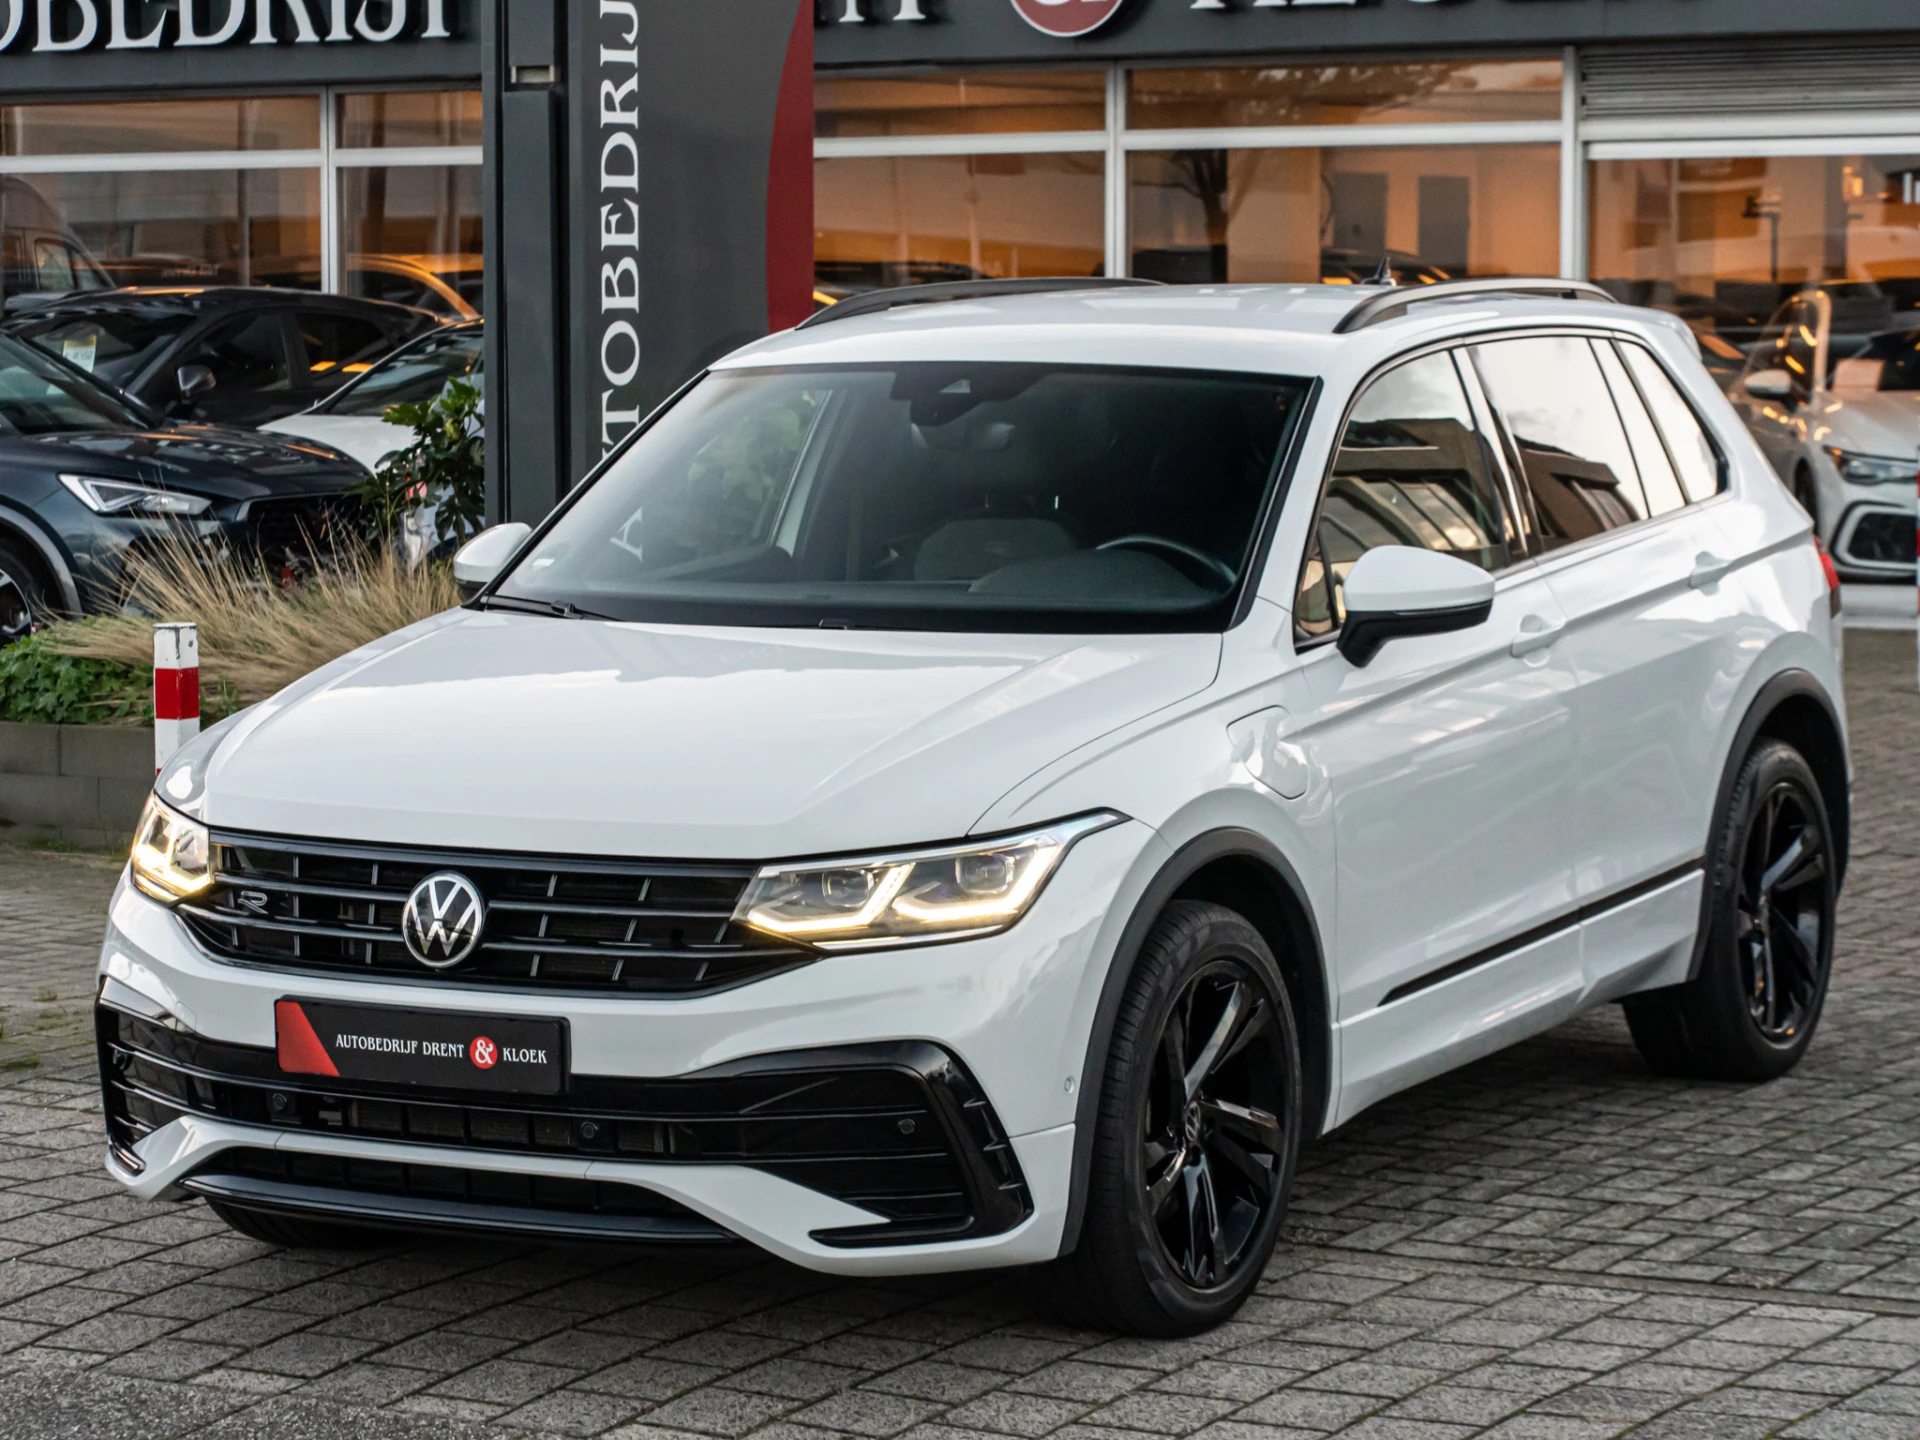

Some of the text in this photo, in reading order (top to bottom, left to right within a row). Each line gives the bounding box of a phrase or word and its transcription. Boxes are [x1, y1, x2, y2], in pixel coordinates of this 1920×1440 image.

[335, 1033, 547, 1065] AUTOBEDRIJF DRENT & KLOEK
